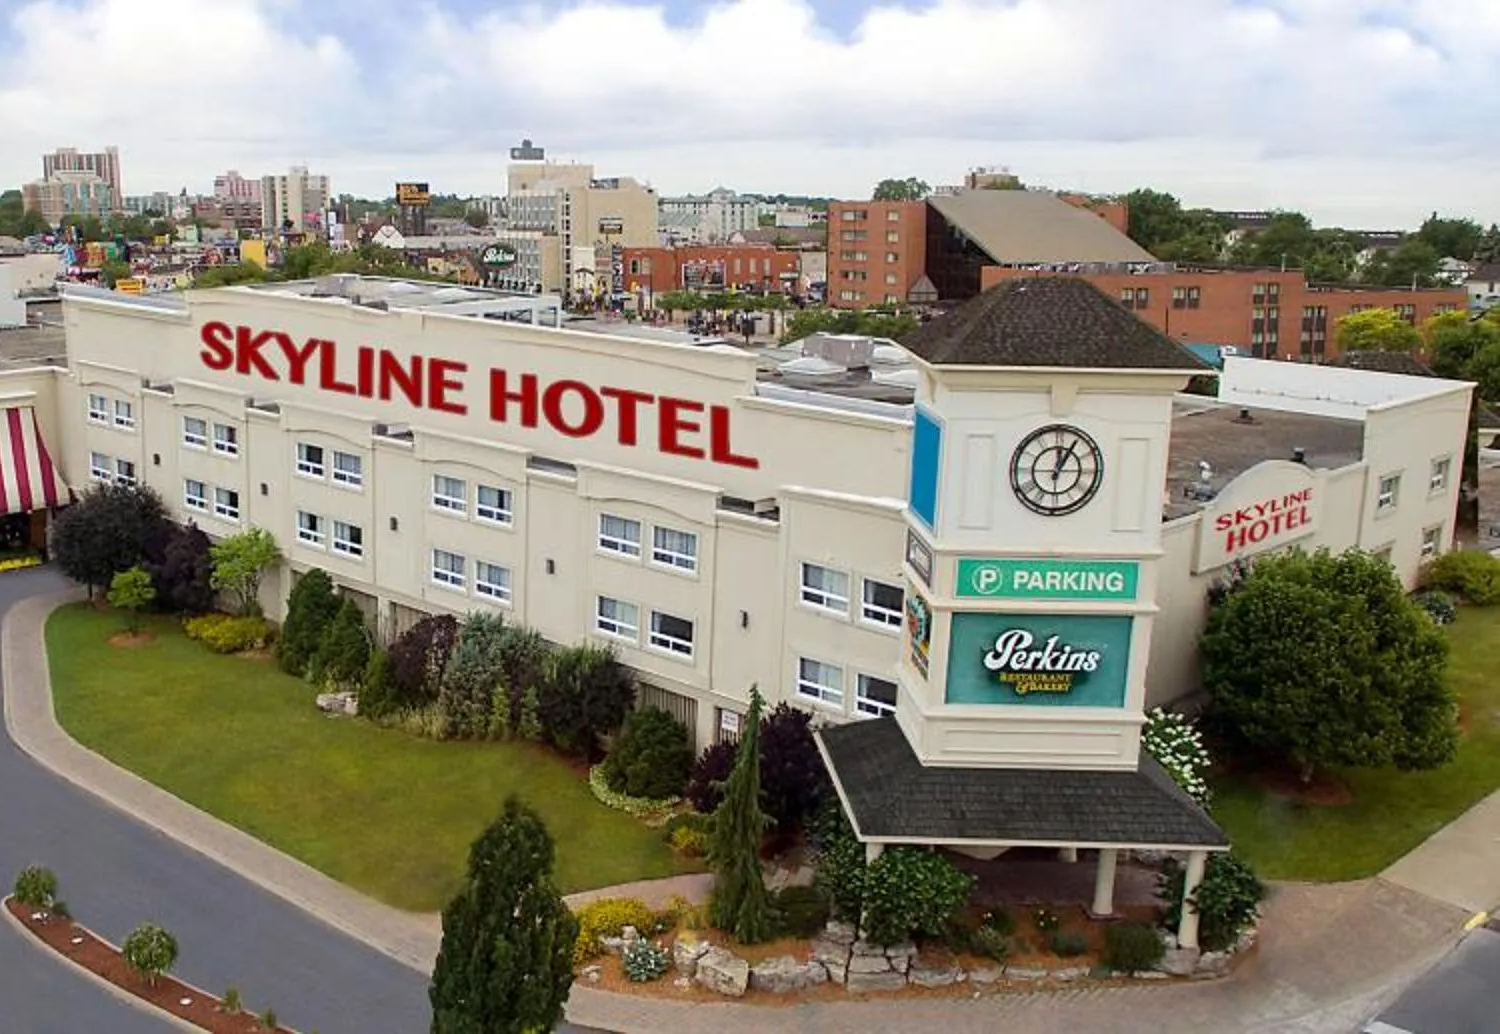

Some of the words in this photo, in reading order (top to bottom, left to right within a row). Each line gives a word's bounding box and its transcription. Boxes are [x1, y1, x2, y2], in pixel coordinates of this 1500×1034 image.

[199, 320, 469, 416] SKYLINE
[489, 367, 759, 470] HOTEL
[1215, 487, 1313, 532] SKYLINE
[1225, 506, 1313, 553] HOTEL
[1013, 570, 1125, 592] PARKING
[983, 629, 1100, 672] Perkins
[1000, 672, 1073, 682] RESTAURANT
